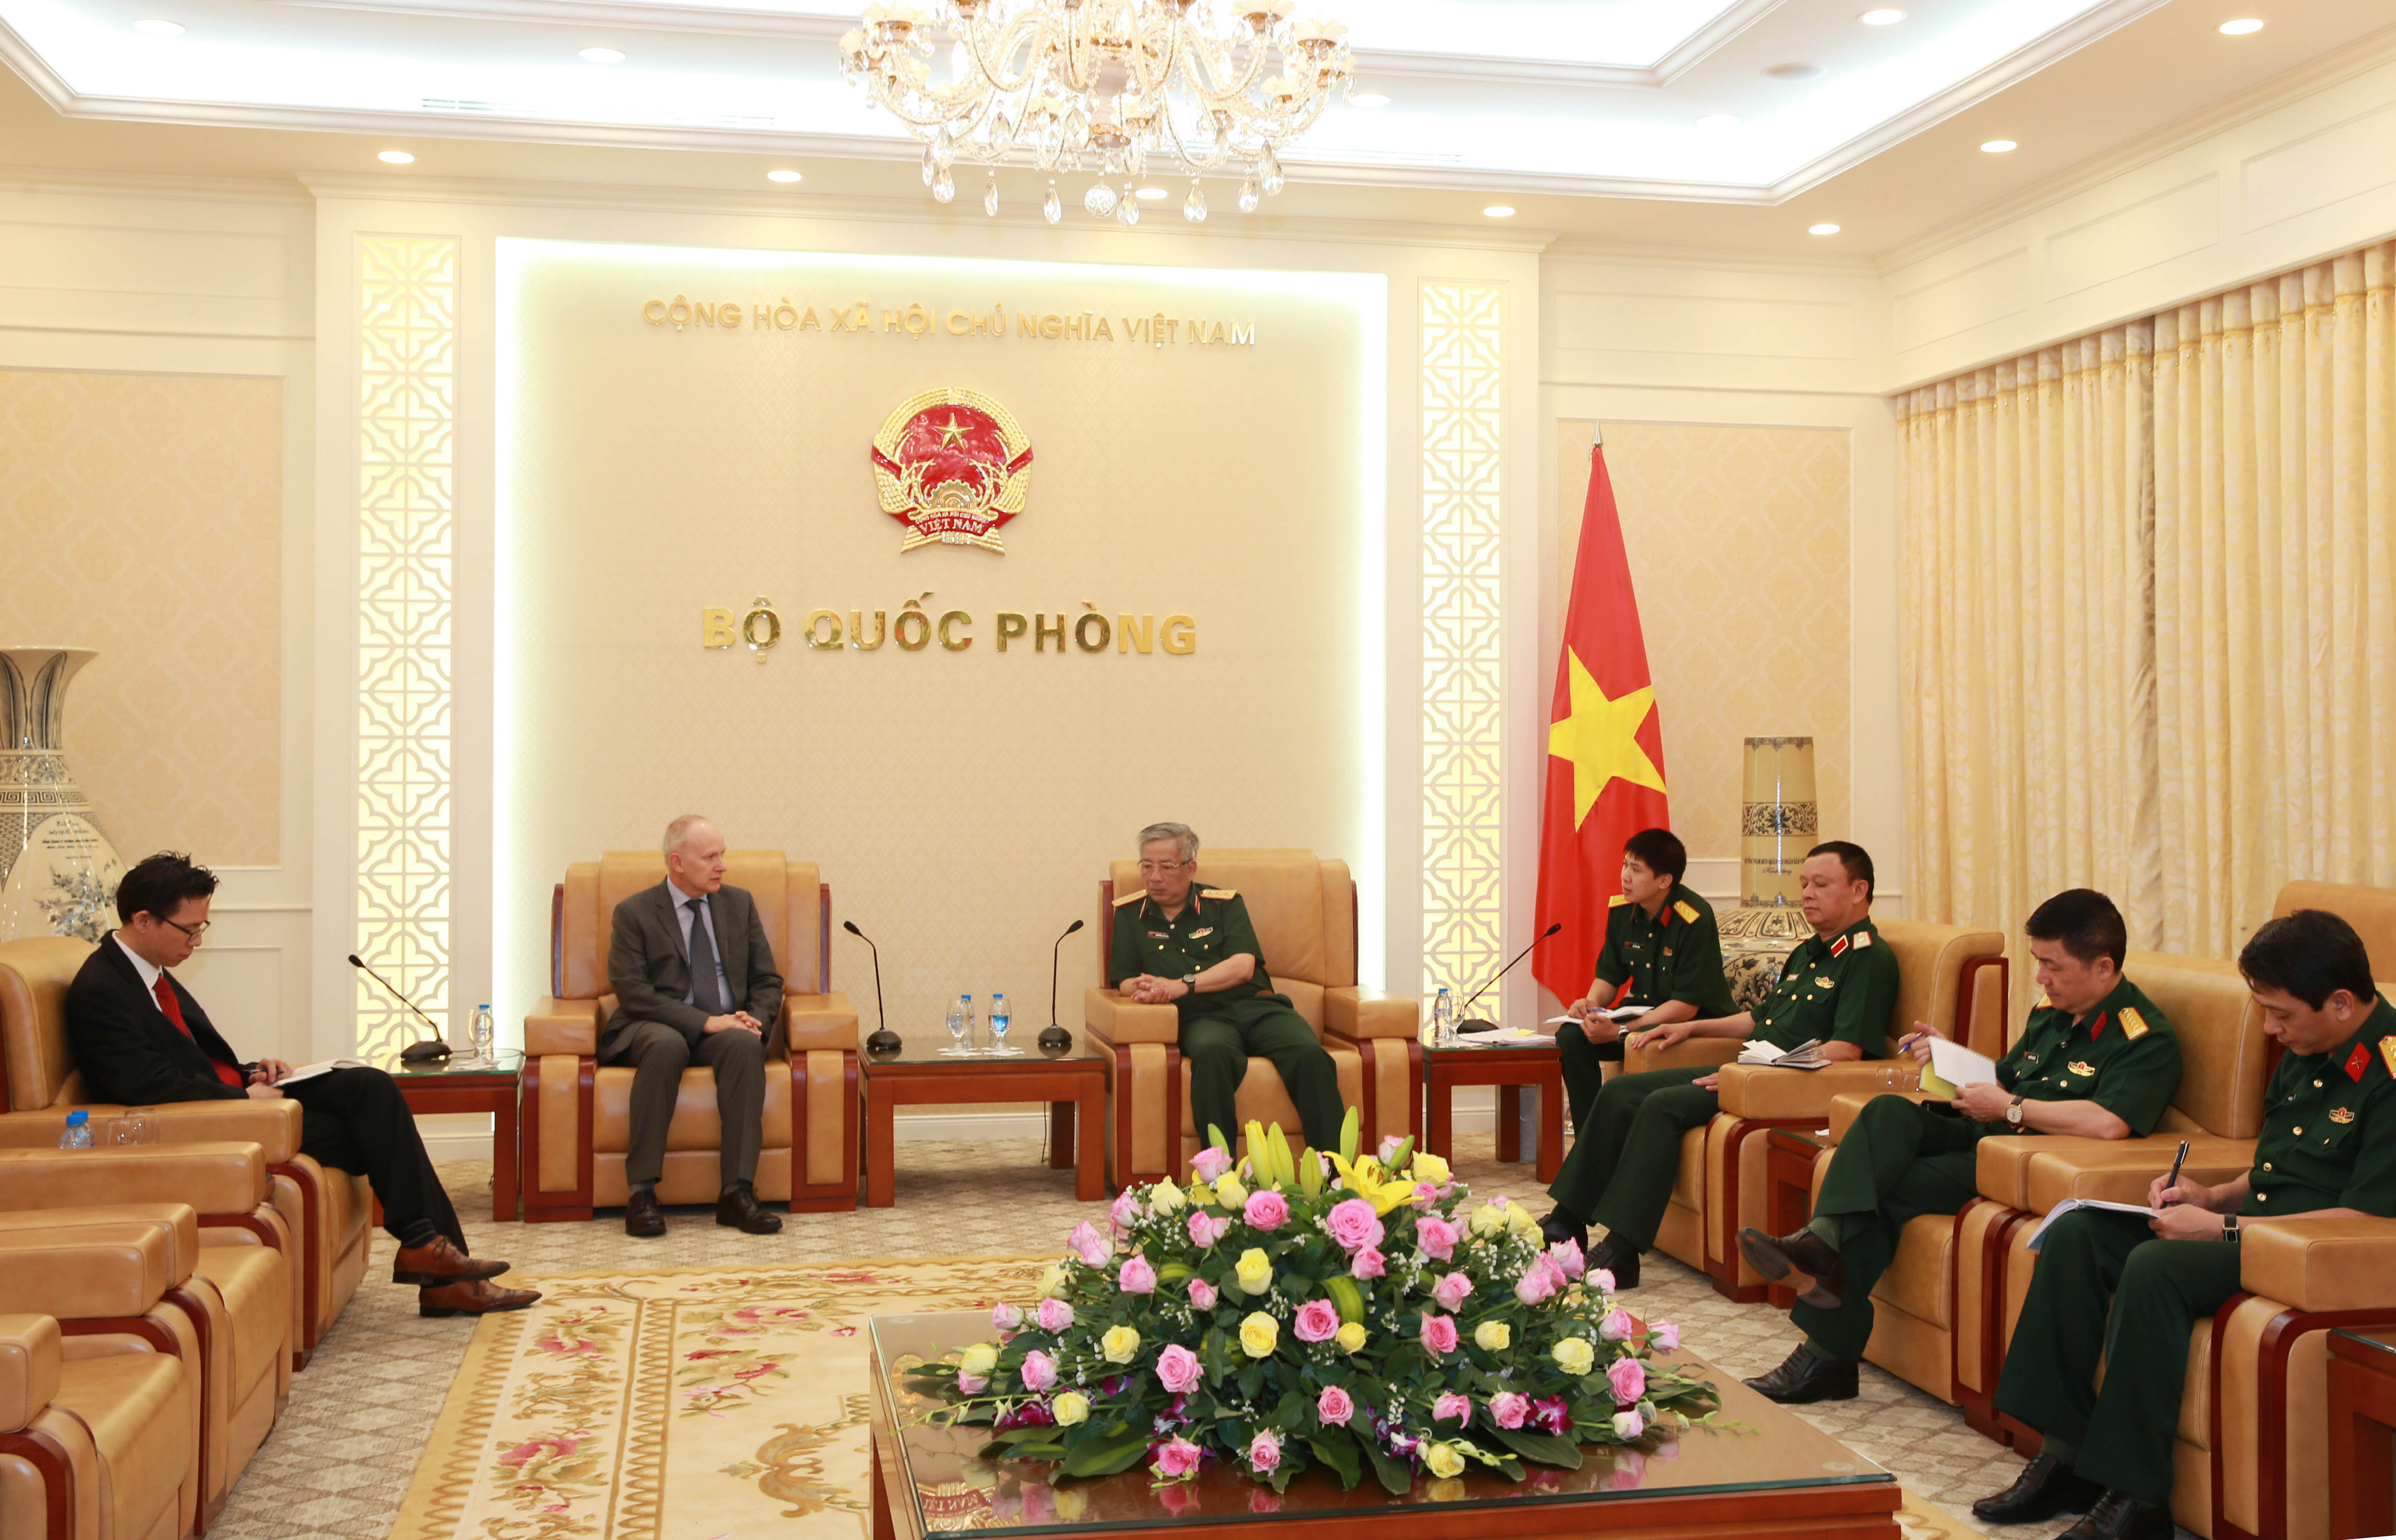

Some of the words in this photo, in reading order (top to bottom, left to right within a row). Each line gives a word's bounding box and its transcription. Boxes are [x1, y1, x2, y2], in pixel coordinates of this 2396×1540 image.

[643, 294, 741, 331] CỘNG
[753, 296, 822, 331] HÒA
[831, 300, 874, 332] XÃ
[884, 303, 936, 341] HỘI
[946, 302, 1008, 336] CHỦ
[1018, 309, 1114, 341] NGHĨA
[1122, 312, 1179, 348] VIỆT
[1189, 318, 1255, 346] NAM
[952, 518, 983, 533] NAM
[703, 596, 782, 664] BỘ
[804, 591, 973, 651] QUỐC
[996, 600, 1196, 655] PHÒNG
